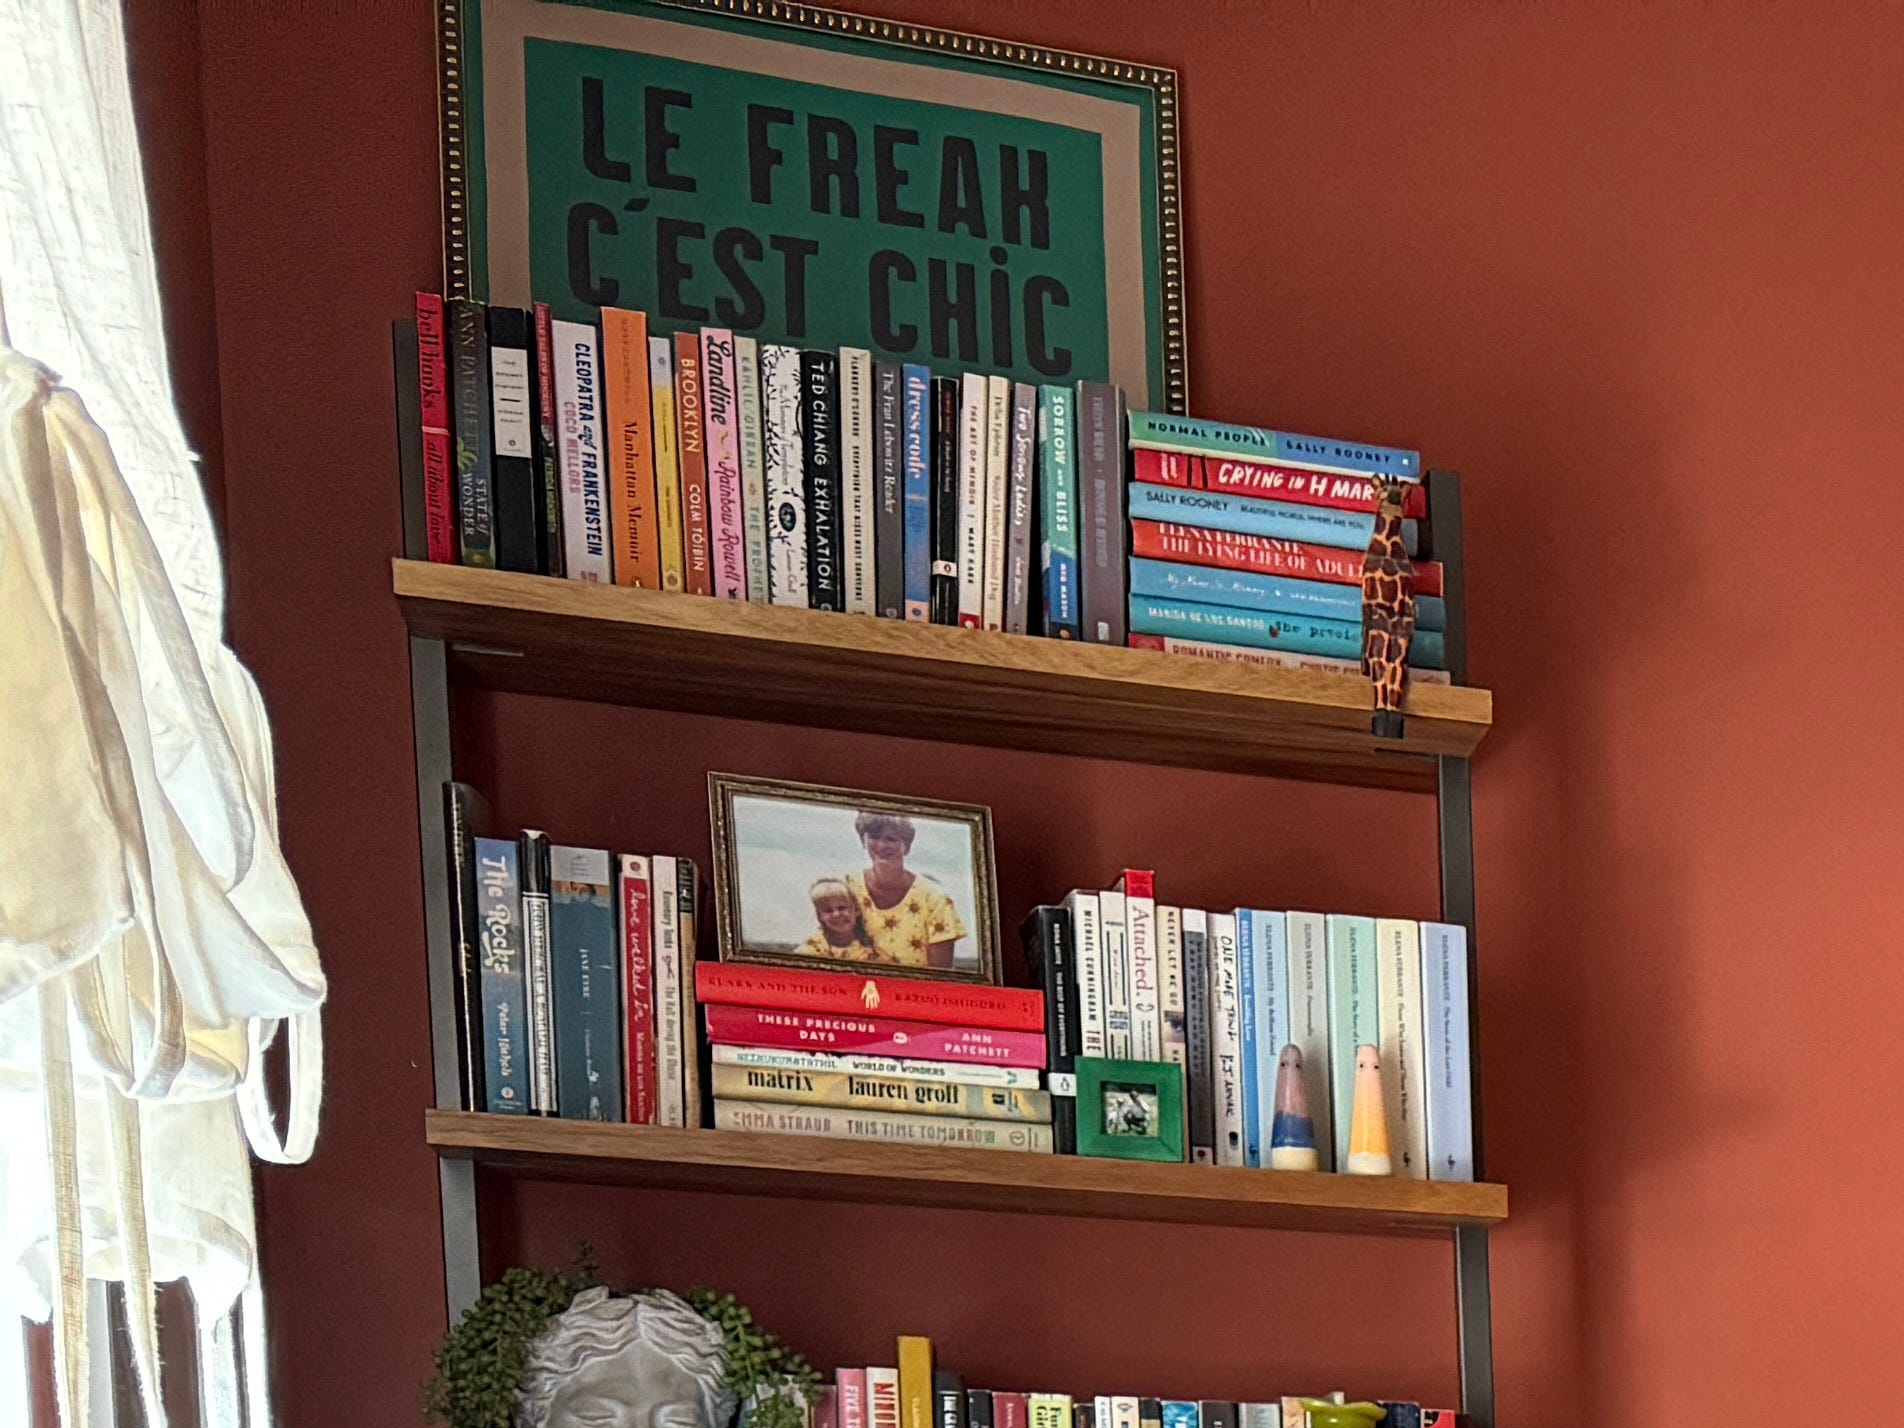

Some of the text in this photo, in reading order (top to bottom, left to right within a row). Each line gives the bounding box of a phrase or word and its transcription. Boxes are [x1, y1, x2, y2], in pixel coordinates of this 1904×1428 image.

[582, 77, 1050, 250] LE FREAK
[680, 358, 700, 453] BROOKLYN
[908, 377, 927, 478] dress code
[1052, 396, 1066, 465] SORROW
[564, 401, 580, 494] COCO MELLORS
[574, 342, 602, 556] CLEOPATRA and FRANKENSTEIN
[706, 335, 741, 582] Landline Rainbow Rowell
[882, 371, 897, 514] The Fran Lebowitz Reader
[1147, 421, 1391, 464] NORMAL PEOPLE SALLY ROONEY
[623, 421, 642, 563] Manhattan Memoir
[688, 484, 701, 521] COLM
[811, 362, 831, 590] TED CHIANG EXHALATION
[1147, 492, 1228, 512] SALLY ROONEY
[462, 472, 474, 536] WONDER
[1056, 491, 1068, 533] BLISS
[1060, 585, 1069, 618] MASON
[481, 855, 507, 897] The
[483, 903, 516, 974] Rocks
[1132, 905, 1152, 997] Attached.
[1084, 910, 1101, 1051] MICHAEL CUNNINGHAM THE
[758, 1013, 877, 1034] THESE PRECIOUS
[799, 1029, 836, 1043] DAYS
[962, 1032, 992, 1044] ANN
[852, 1059, 946, 1076] WORLD OF WONDERS
[944, 1044, 1011, 1058] PATCHETT
[747, 1070, 959, 1104] matrix lauren groff
[733, 1111, 996, 1144] EMMA STRAUB THIS TIME TOMORROW
[845, 1384, 858, 1412] FIVE
